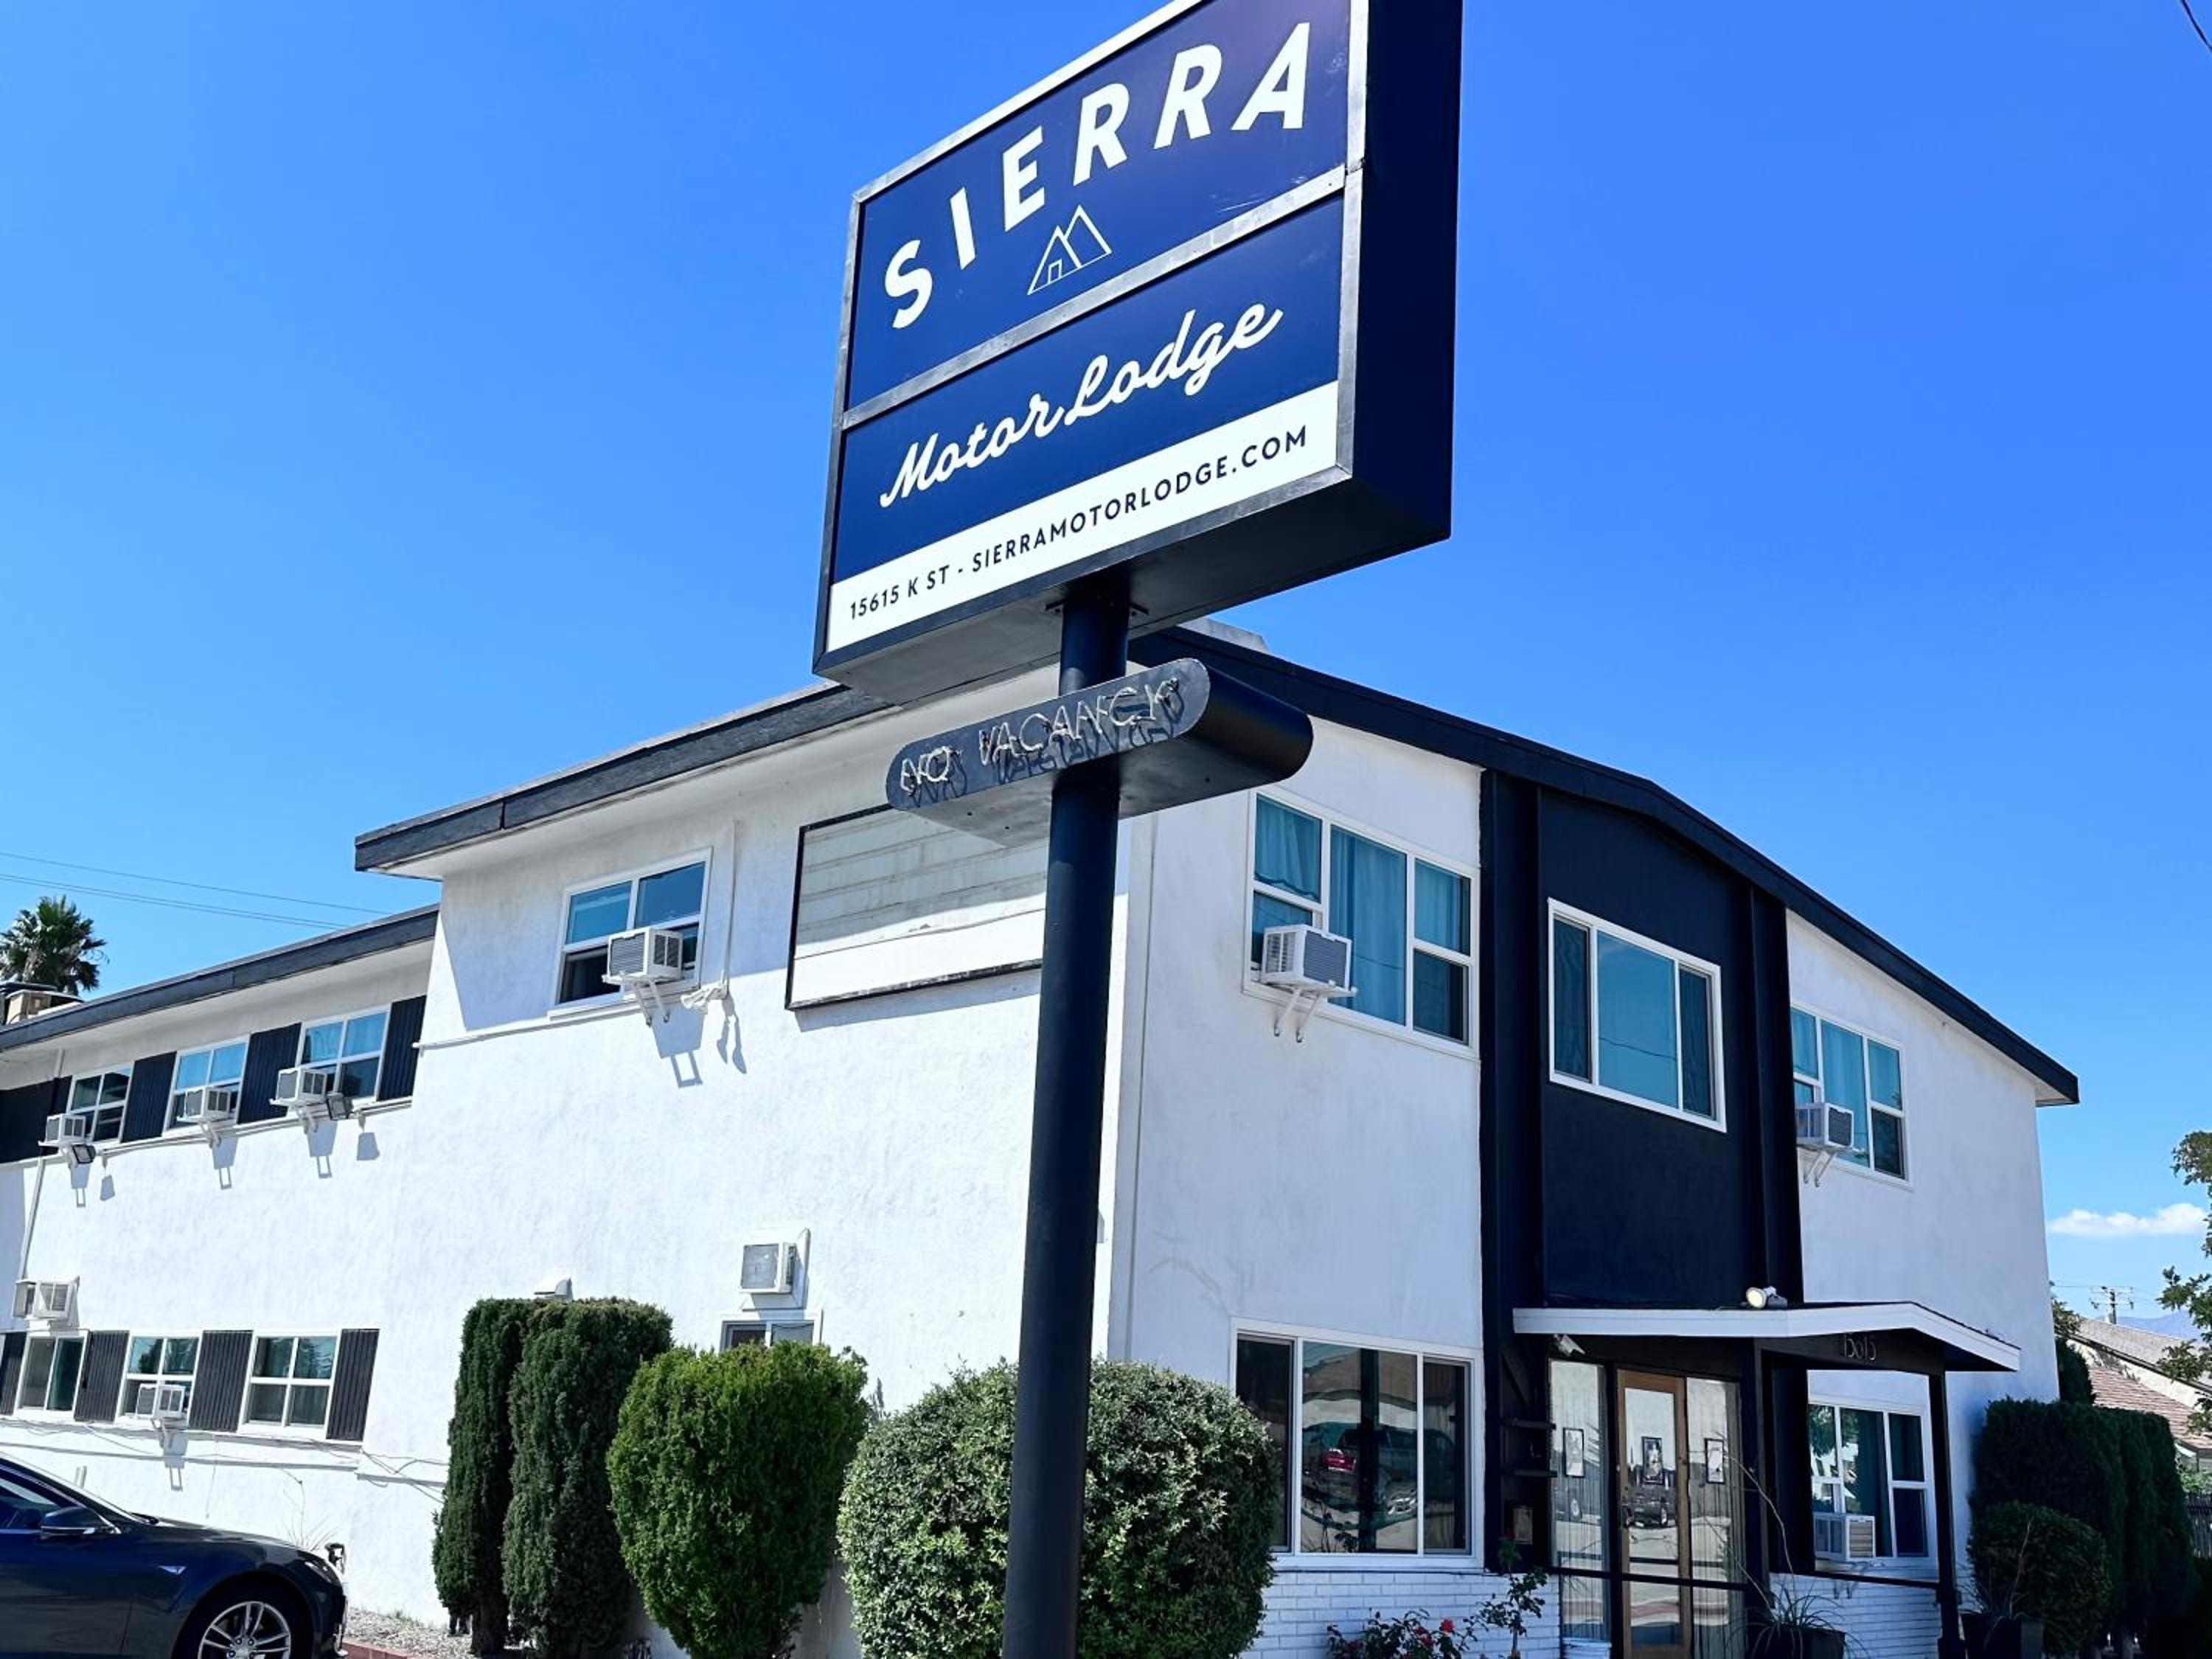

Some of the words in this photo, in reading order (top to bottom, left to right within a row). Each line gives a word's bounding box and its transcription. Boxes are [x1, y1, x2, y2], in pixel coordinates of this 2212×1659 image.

[884, 22, 1310, 330] SIERRA
[879, 392, 1066, 508] Motor
[1064, 303, 1284, 427] Lodge
[850, 585, 900, 620] 15615
[908, 577, 919, 598] K
[927, 565, 950, 590] ST
[972, 425, 1307, 573] SIERRAMOTORLODGE.COM
[900, 745, 955, 793] NO
[978, 678, 1180, 766] VACANCY
